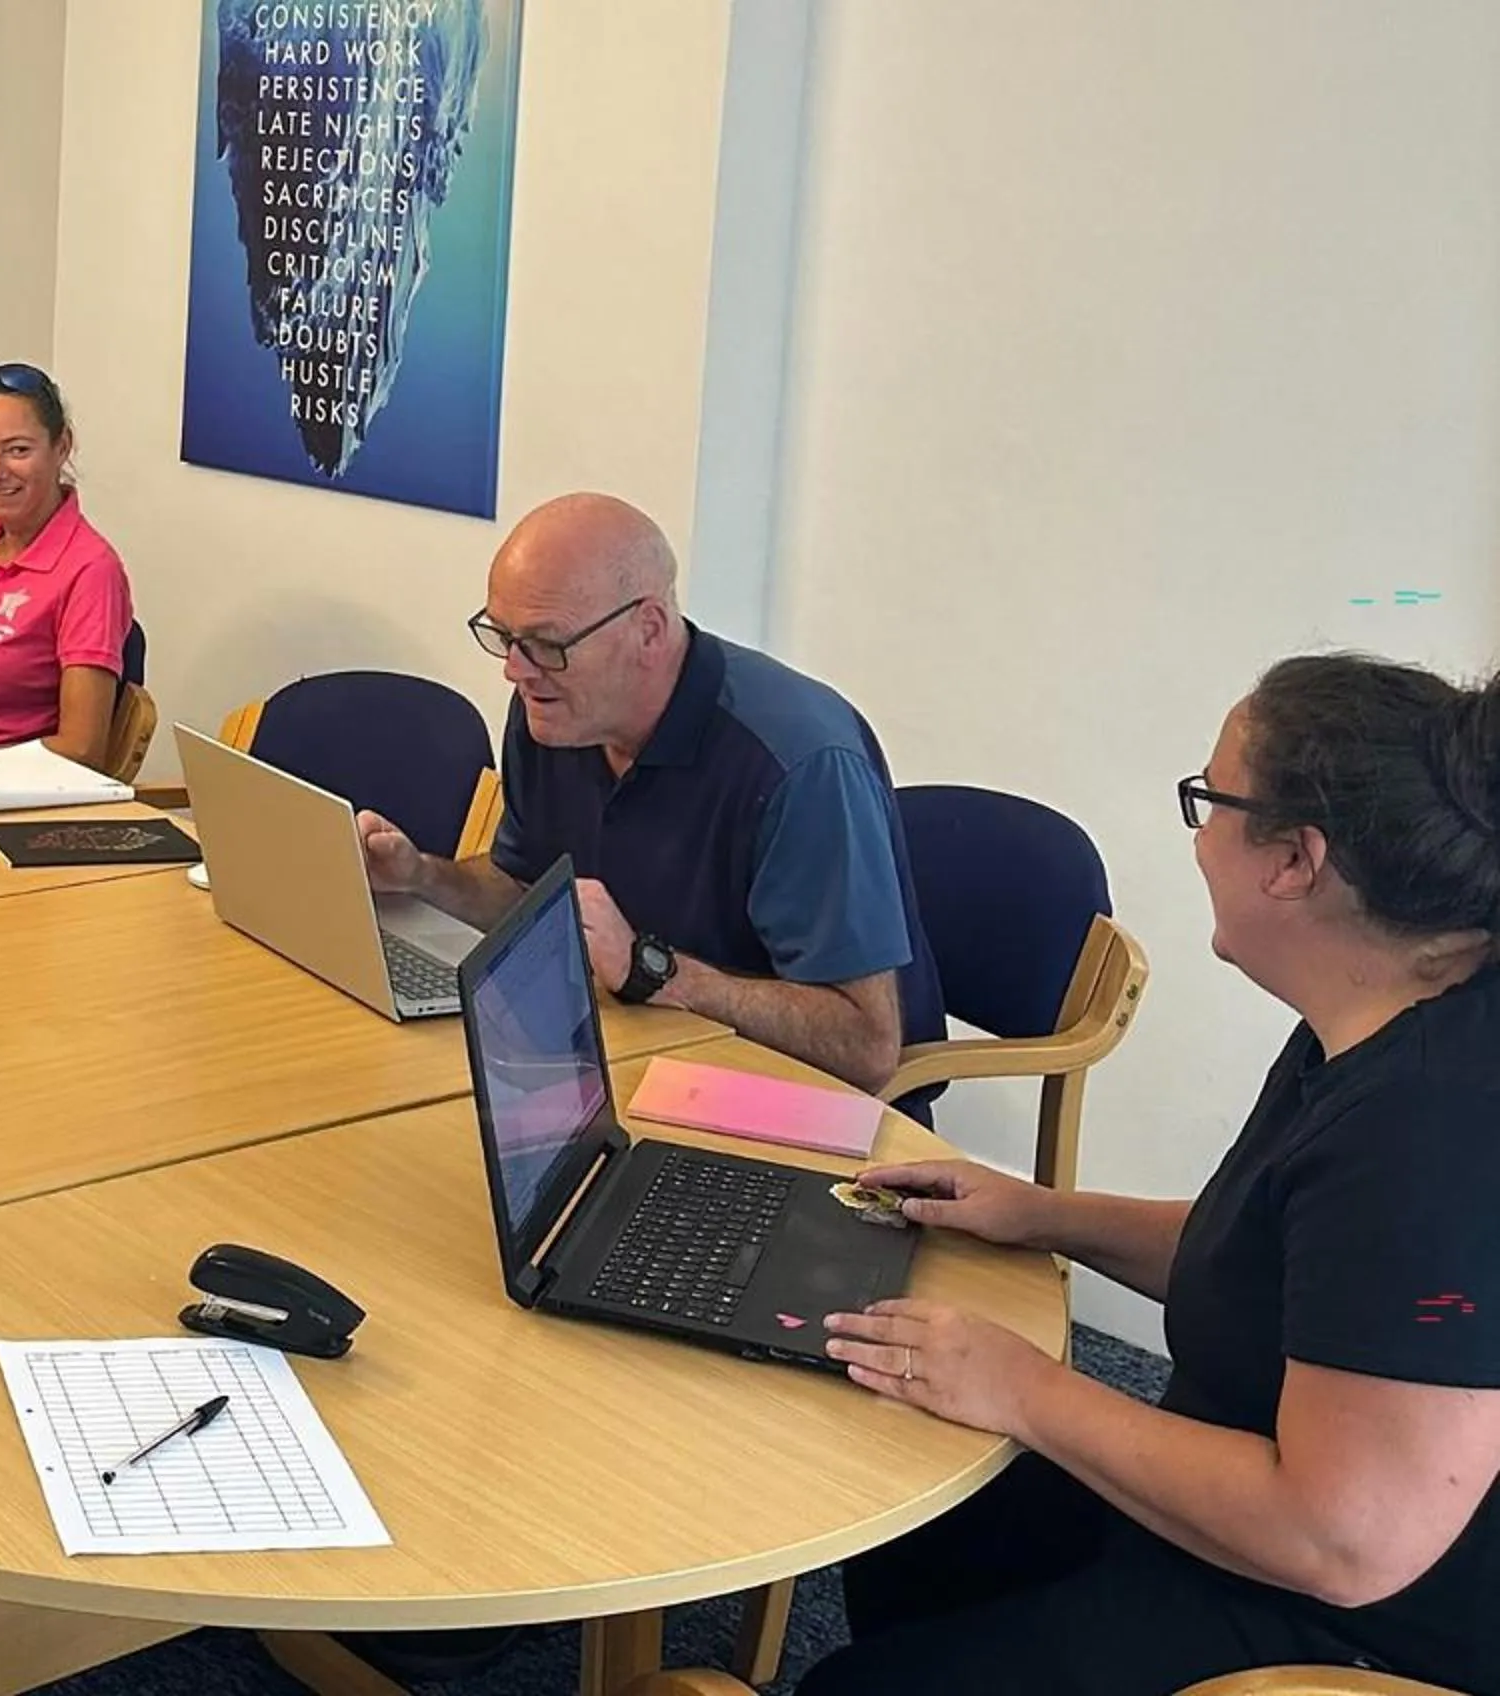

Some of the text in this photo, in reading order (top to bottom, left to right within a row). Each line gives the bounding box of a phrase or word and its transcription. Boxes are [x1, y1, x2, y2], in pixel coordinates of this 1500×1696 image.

[255, 3, 437, 29] CONSISTENCY
[265, 41, 421, 66] HARD WORK
[259, 76, 425, 103] PERSISTENCE
[257, 111, 422, 140] LATE NIGHTS
[261, 145, 414, 176] REJECTIONS
[263, 181, 409, 213] SACRIFICES
[264, 216, 403, 251] DISCIPLINE
[268, 252, 395, 286] CRITICISM
[279, 287, 378, 322] FAILURE
[278, 323, 378, 358] DOUBTS
[281, 359, 372, 393] HUSTLE
[290, 394, 359, 427] RISKS
